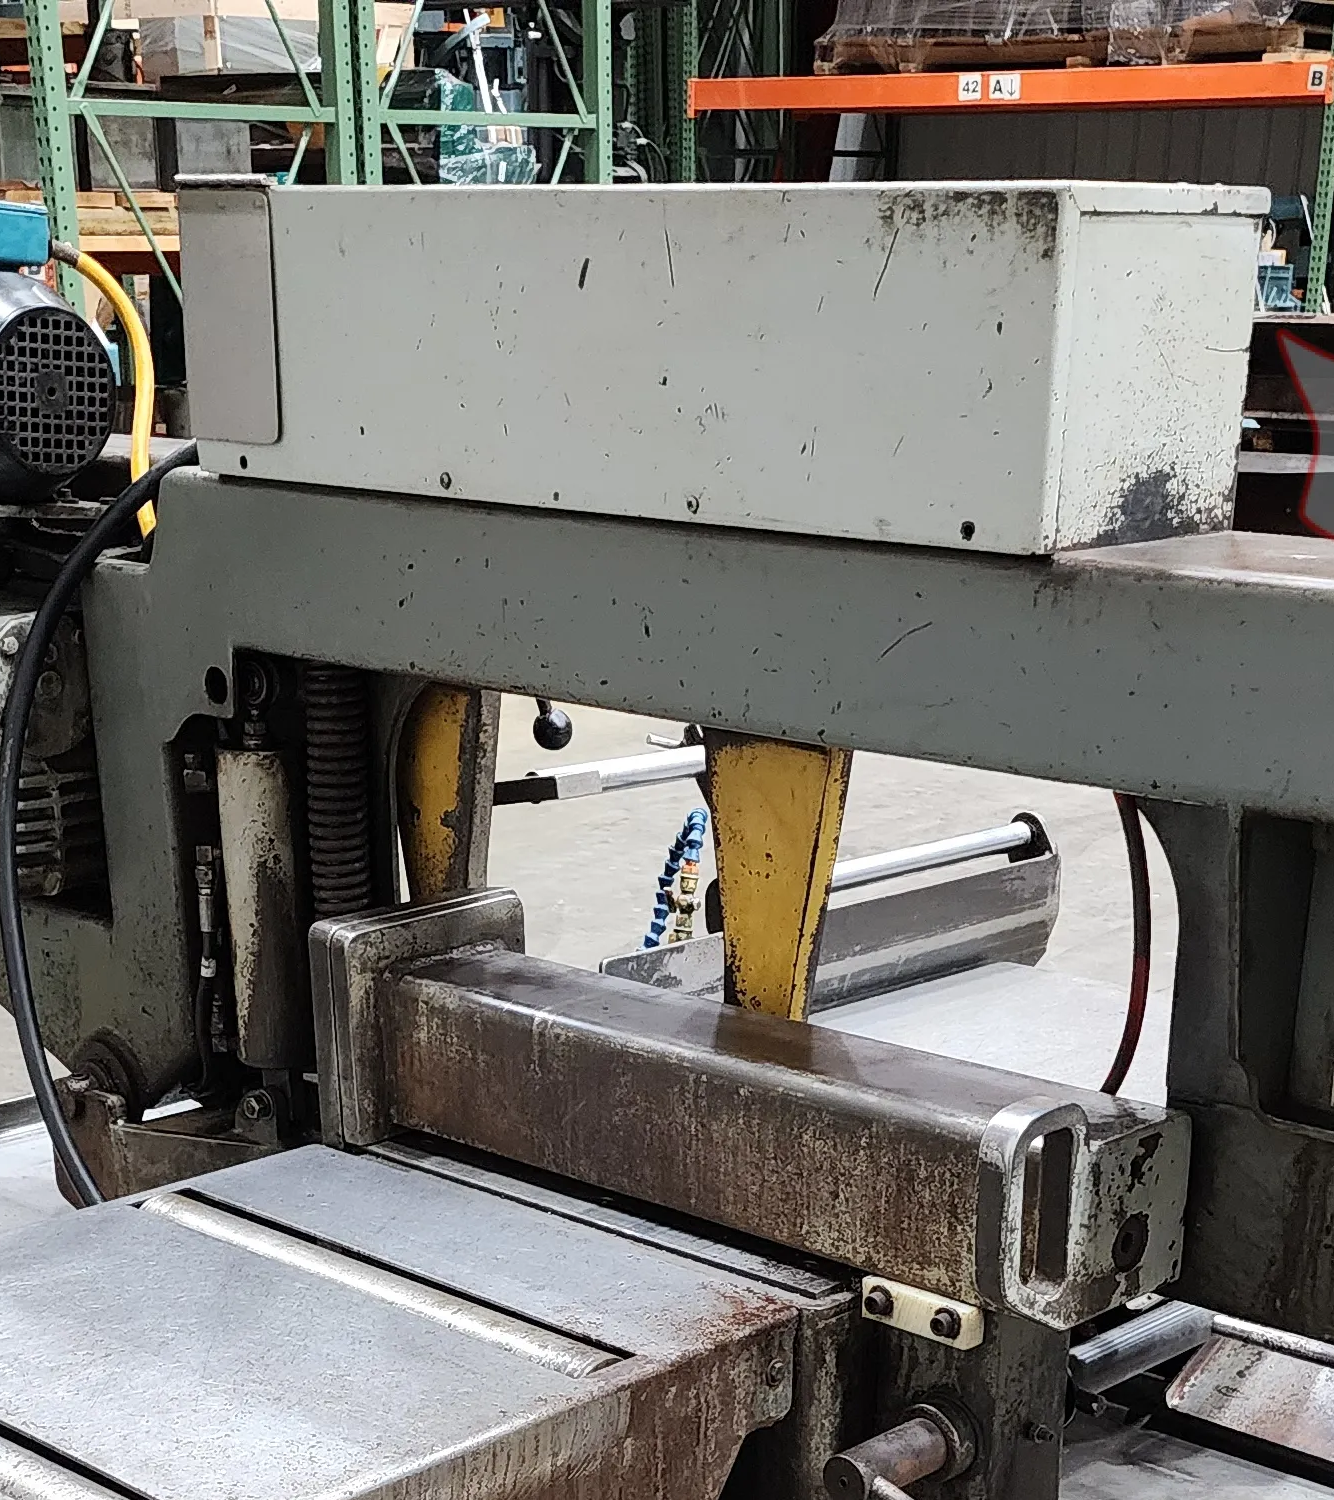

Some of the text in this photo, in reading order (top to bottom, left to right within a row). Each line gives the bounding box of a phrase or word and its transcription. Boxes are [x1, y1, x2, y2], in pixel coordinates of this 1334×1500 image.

[1311, 70, 1323, 86] B
[962, 79, 1003, 95] 42 A
